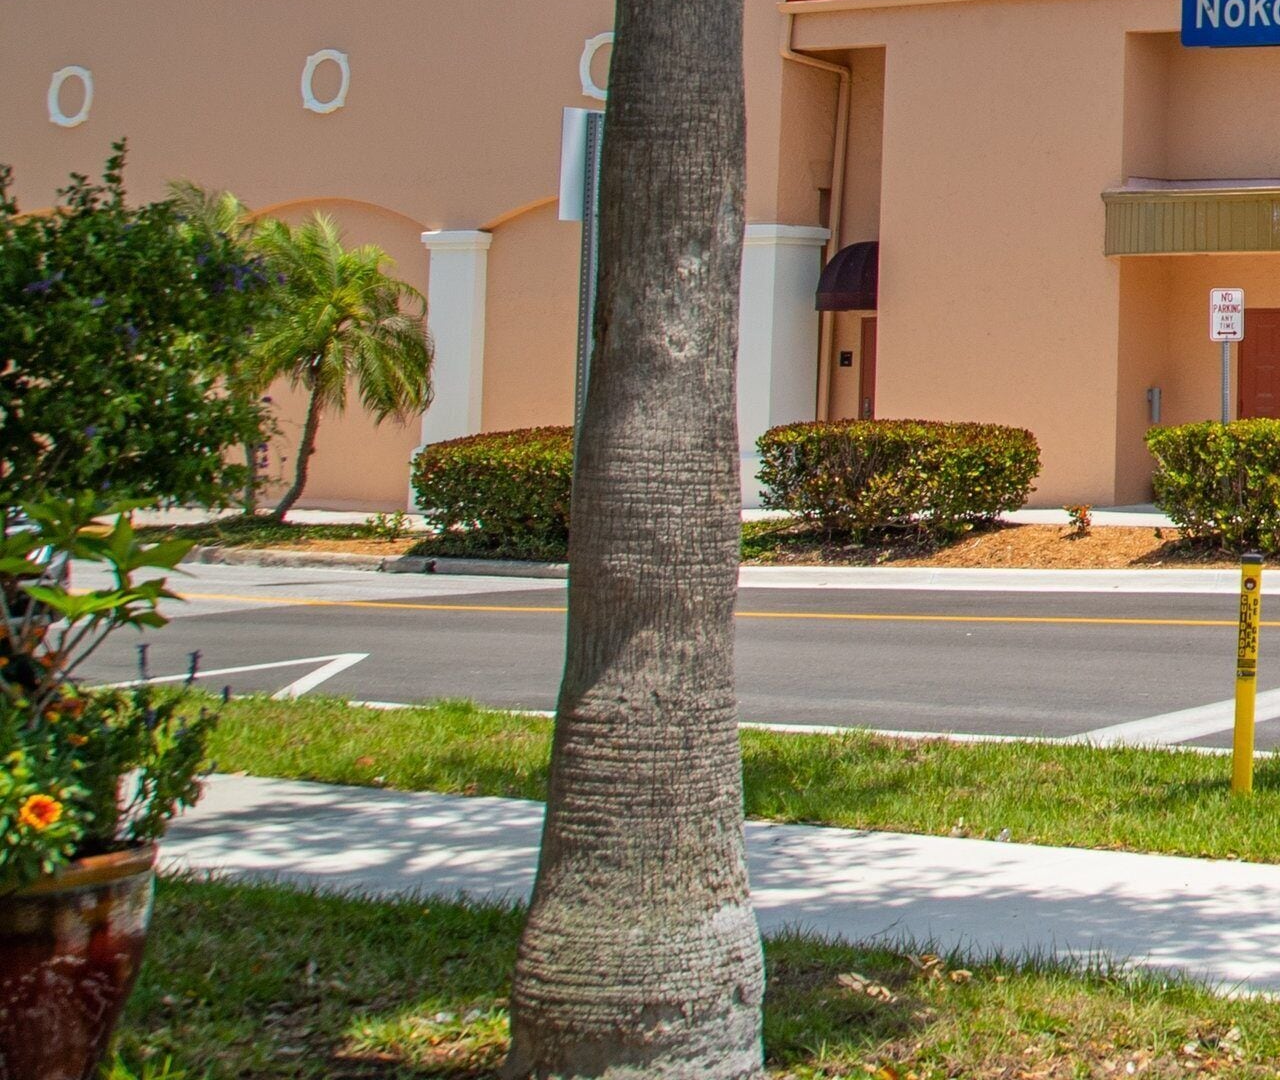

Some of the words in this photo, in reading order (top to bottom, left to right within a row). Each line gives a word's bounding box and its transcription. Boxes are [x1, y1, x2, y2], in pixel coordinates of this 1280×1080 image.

[1221, 292, 1233, 302] NO
[1213, 304, 1241, 313] PARKING
[1239, 595, 1248, 657] CUIDADO
